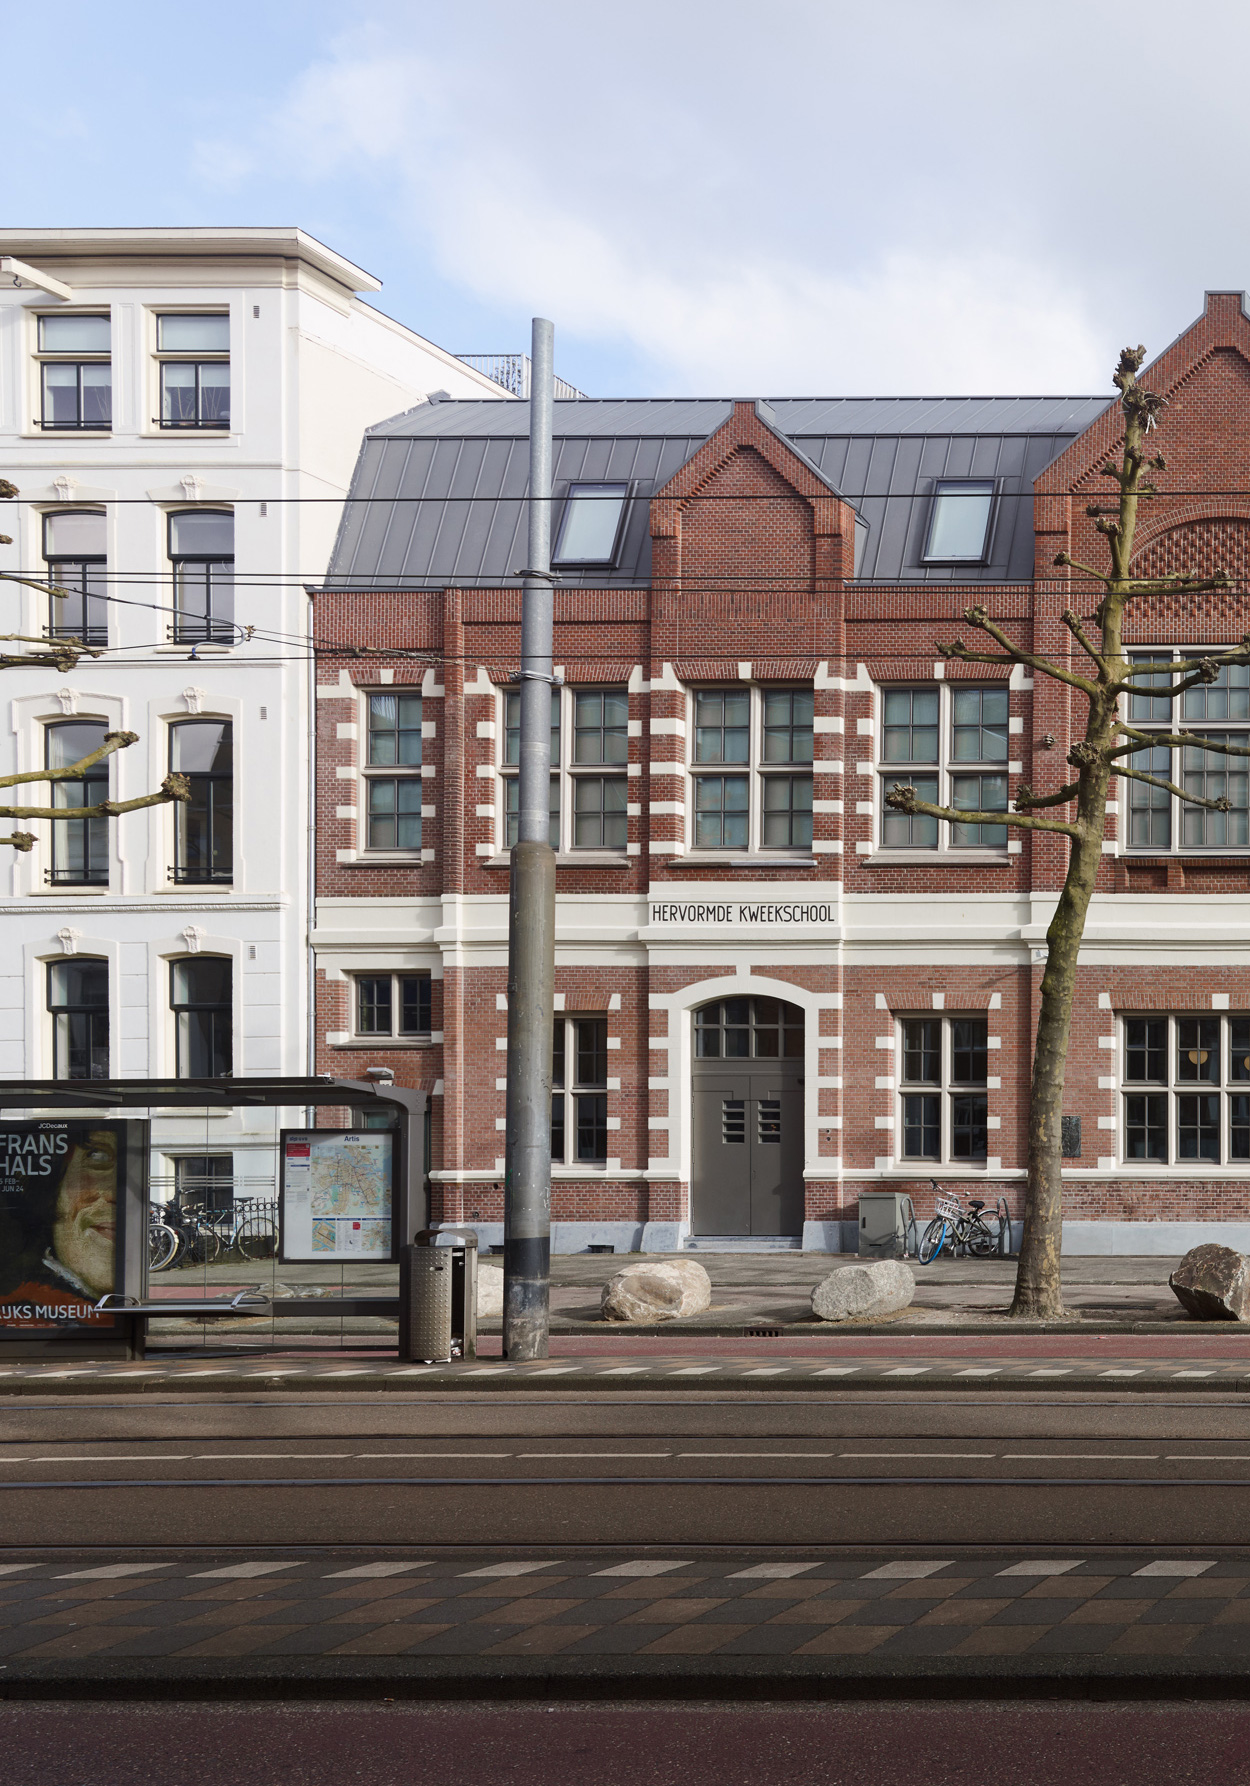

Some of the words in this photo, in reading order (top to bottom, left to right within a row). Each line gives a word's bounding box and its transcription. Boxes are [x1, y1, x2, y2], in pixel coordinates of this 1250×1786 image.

[652, 905, 733, 922] HERVORMDE
[739, 905, 835, 922] KWEEKSCHOOL
[0, 1155, 52, 1176] HALS
[0, 1305, 32, 1319] IJKS
[35, 1305, 99, 1319] MUSEUM
